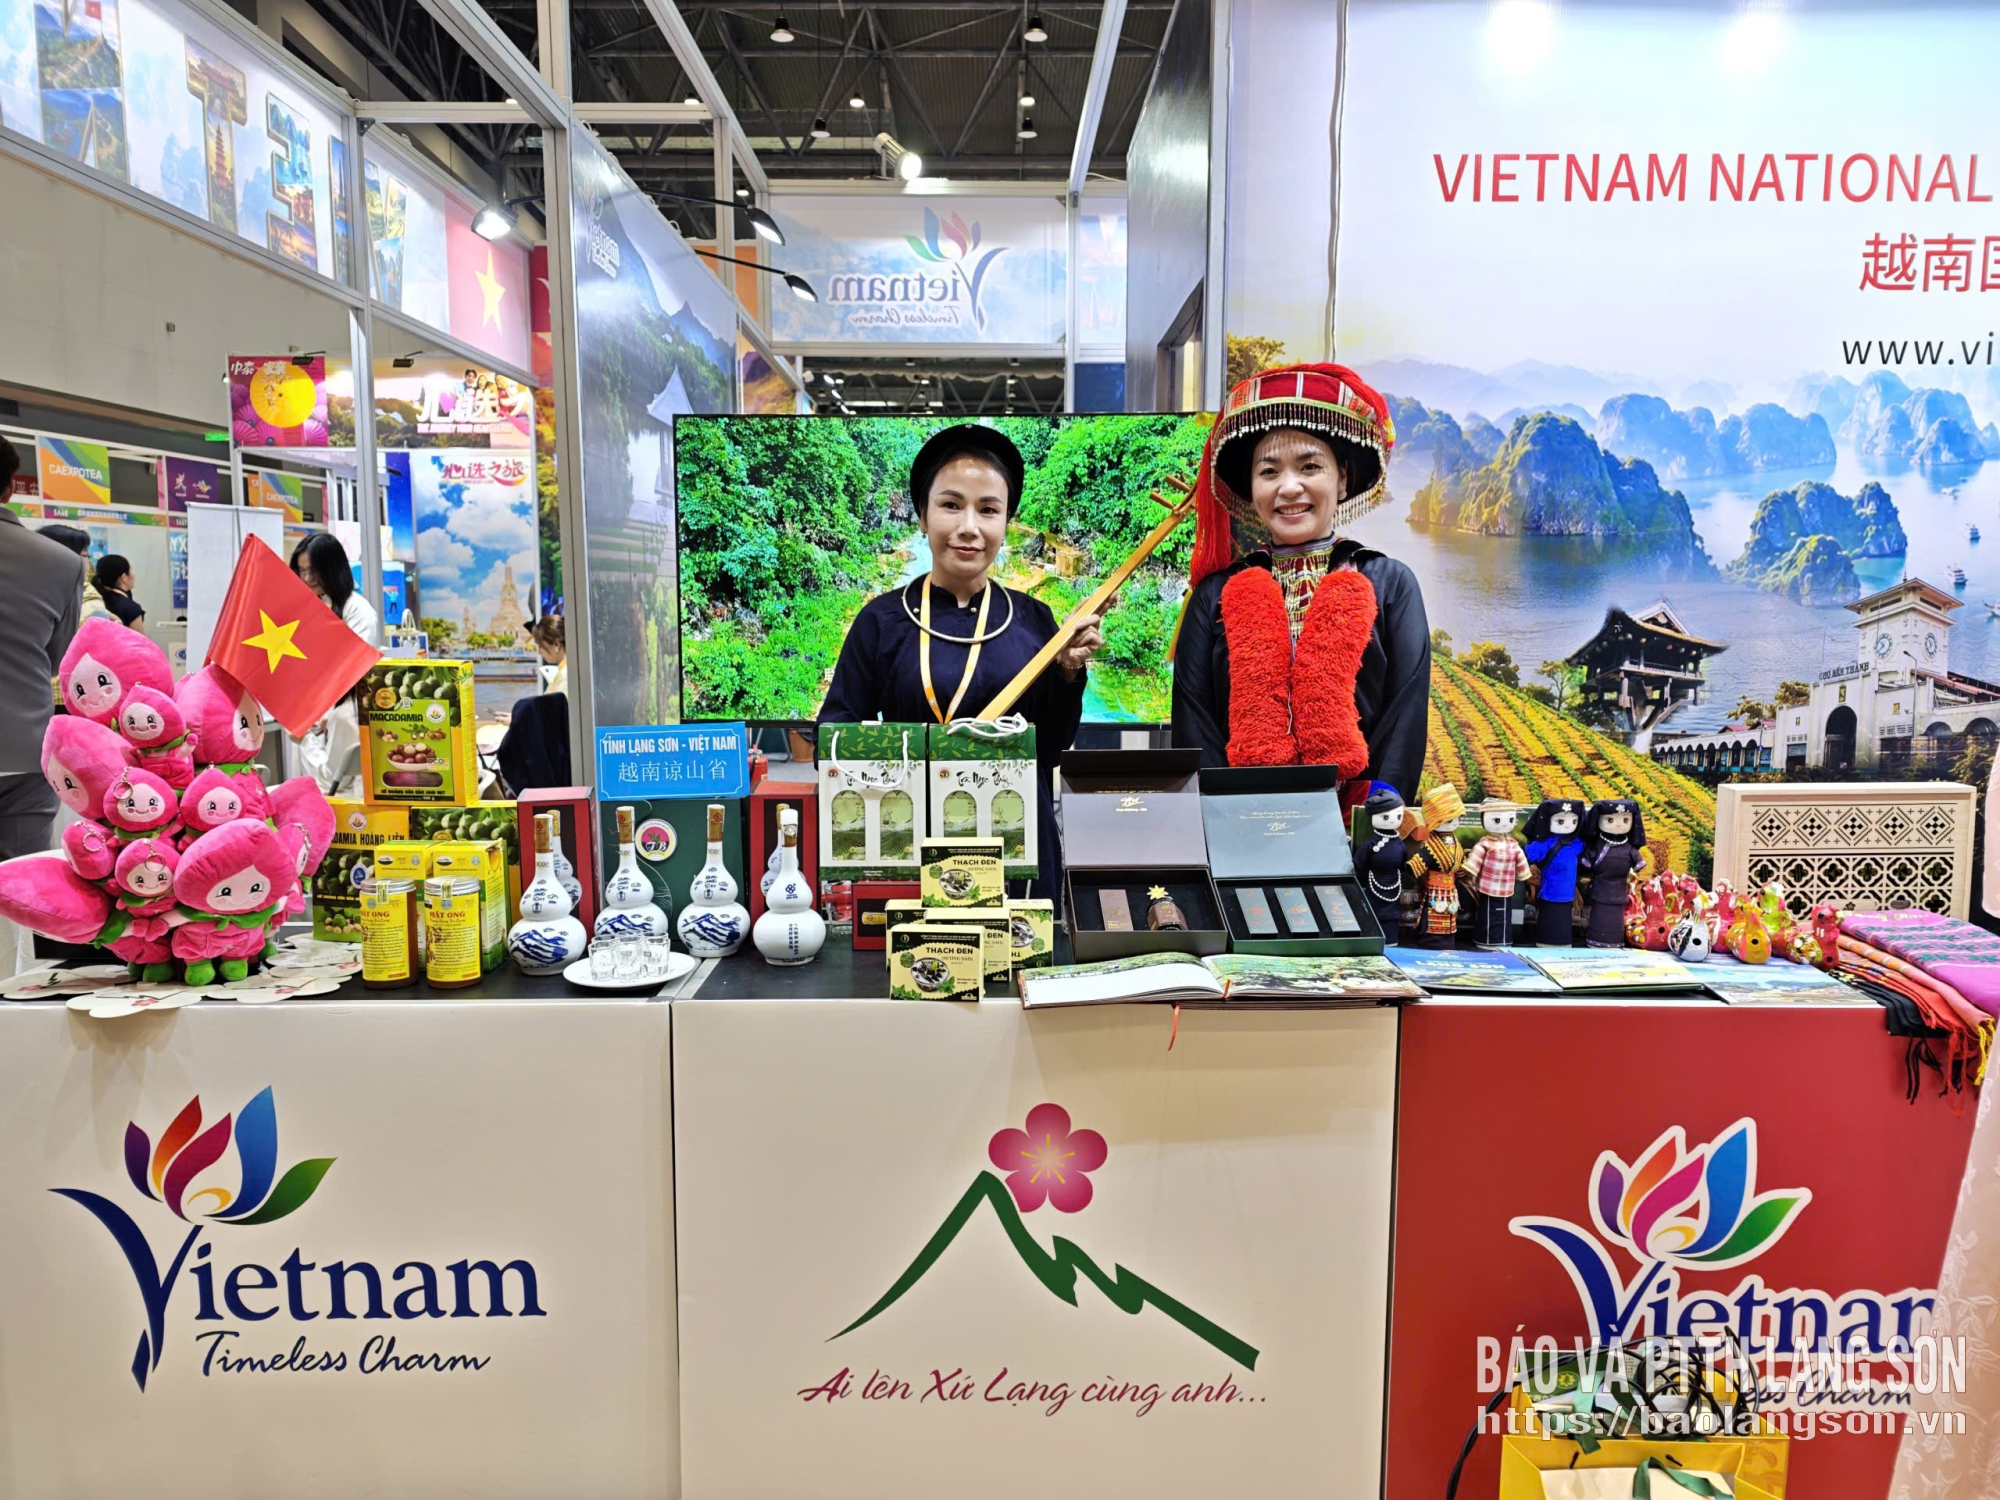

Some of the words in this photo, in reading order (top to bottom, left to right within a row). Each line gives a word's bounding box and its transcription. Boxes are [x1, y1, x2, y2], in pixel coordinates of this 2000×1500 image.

[1433, 153, 1687, 202] VIETNAM
[1709, 153, 1993, 202] NATIONAL
[1843, 332, 1994, 365] www.vi
[48, 463, 103, 480] CAEXPOTEA
[369, 712, 424, 722] MACADAMIA
[602, 735, 626, 754] TỈNH
[628, 738, 655, 757] LẠNG
[658, 736, 679, 752] SƠN
[688, 734, 710, 755] VIỆT
[712, 736, 737, 751] NAM
[618, 758, 728, 782] 越南谅山省
[331, 832, 357, 845] DAMIA
[360, 831, 385, 846] HOÀNG
[953, 859, 979, 867] THẠCH
[446, 911, 466, 919] ONG
[926, 946, 955, 955] THẠCH
[46, 1188, 547, 1393] Vietnam
[195, 1331, 347, 1377] Timeless
[359, 1335, 491, 1374] Charm
[797, 1367, 854, 1404] Ai
[861, 1368, 913, 1400] lên
[920, 1368, 975, 1404] Xứ
[983, 1367, 1076, 1417] Lạng
[1081, 1375, 1164, 1418] cùng
[1171, 1371, 1267, 1404] anh...
